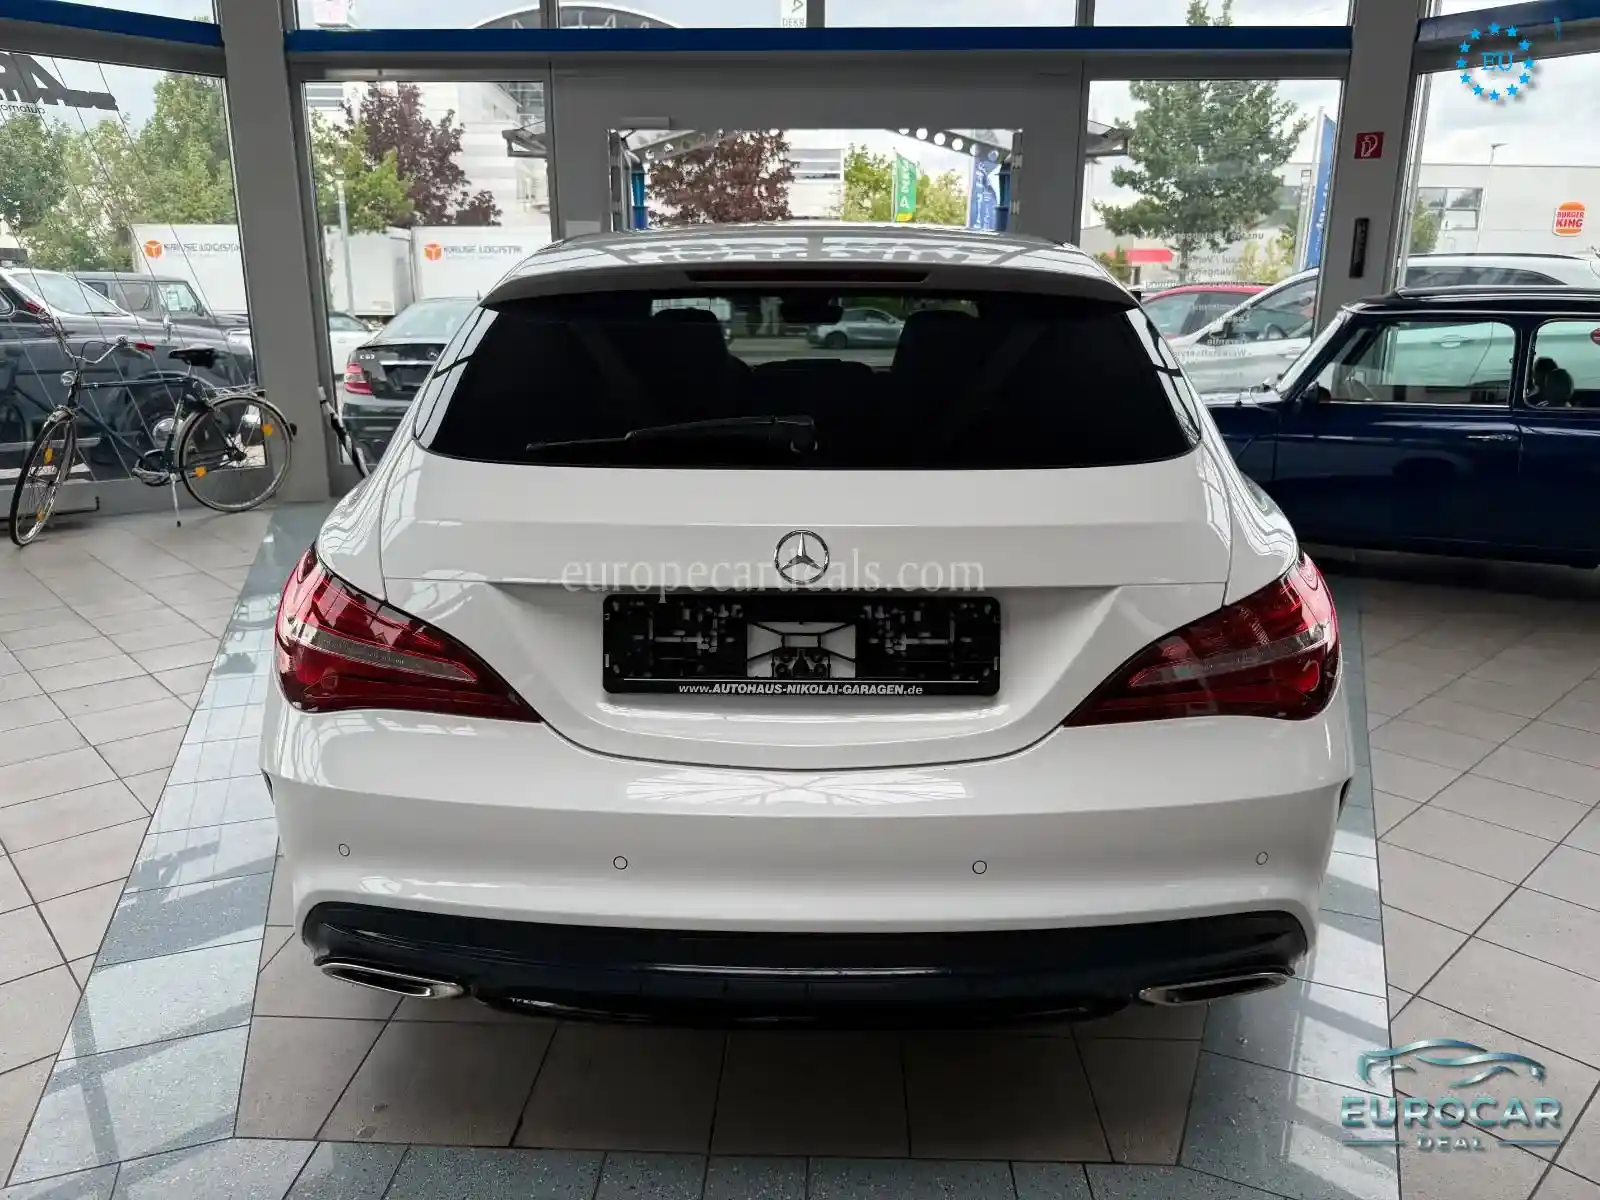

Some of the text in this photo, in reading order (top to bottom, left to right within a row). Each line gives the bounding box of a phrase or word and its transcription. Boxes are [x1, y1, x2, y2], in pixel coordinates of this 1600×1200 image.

[782, 18, 805, 28] DEKR
[1556, 211, 1585, 219] BURGER
[1555, 218, 1584, 228] KING
[678, 683, 924, 695] www.AUTOHAUS-NIKOLAI-GARAGEN.de
